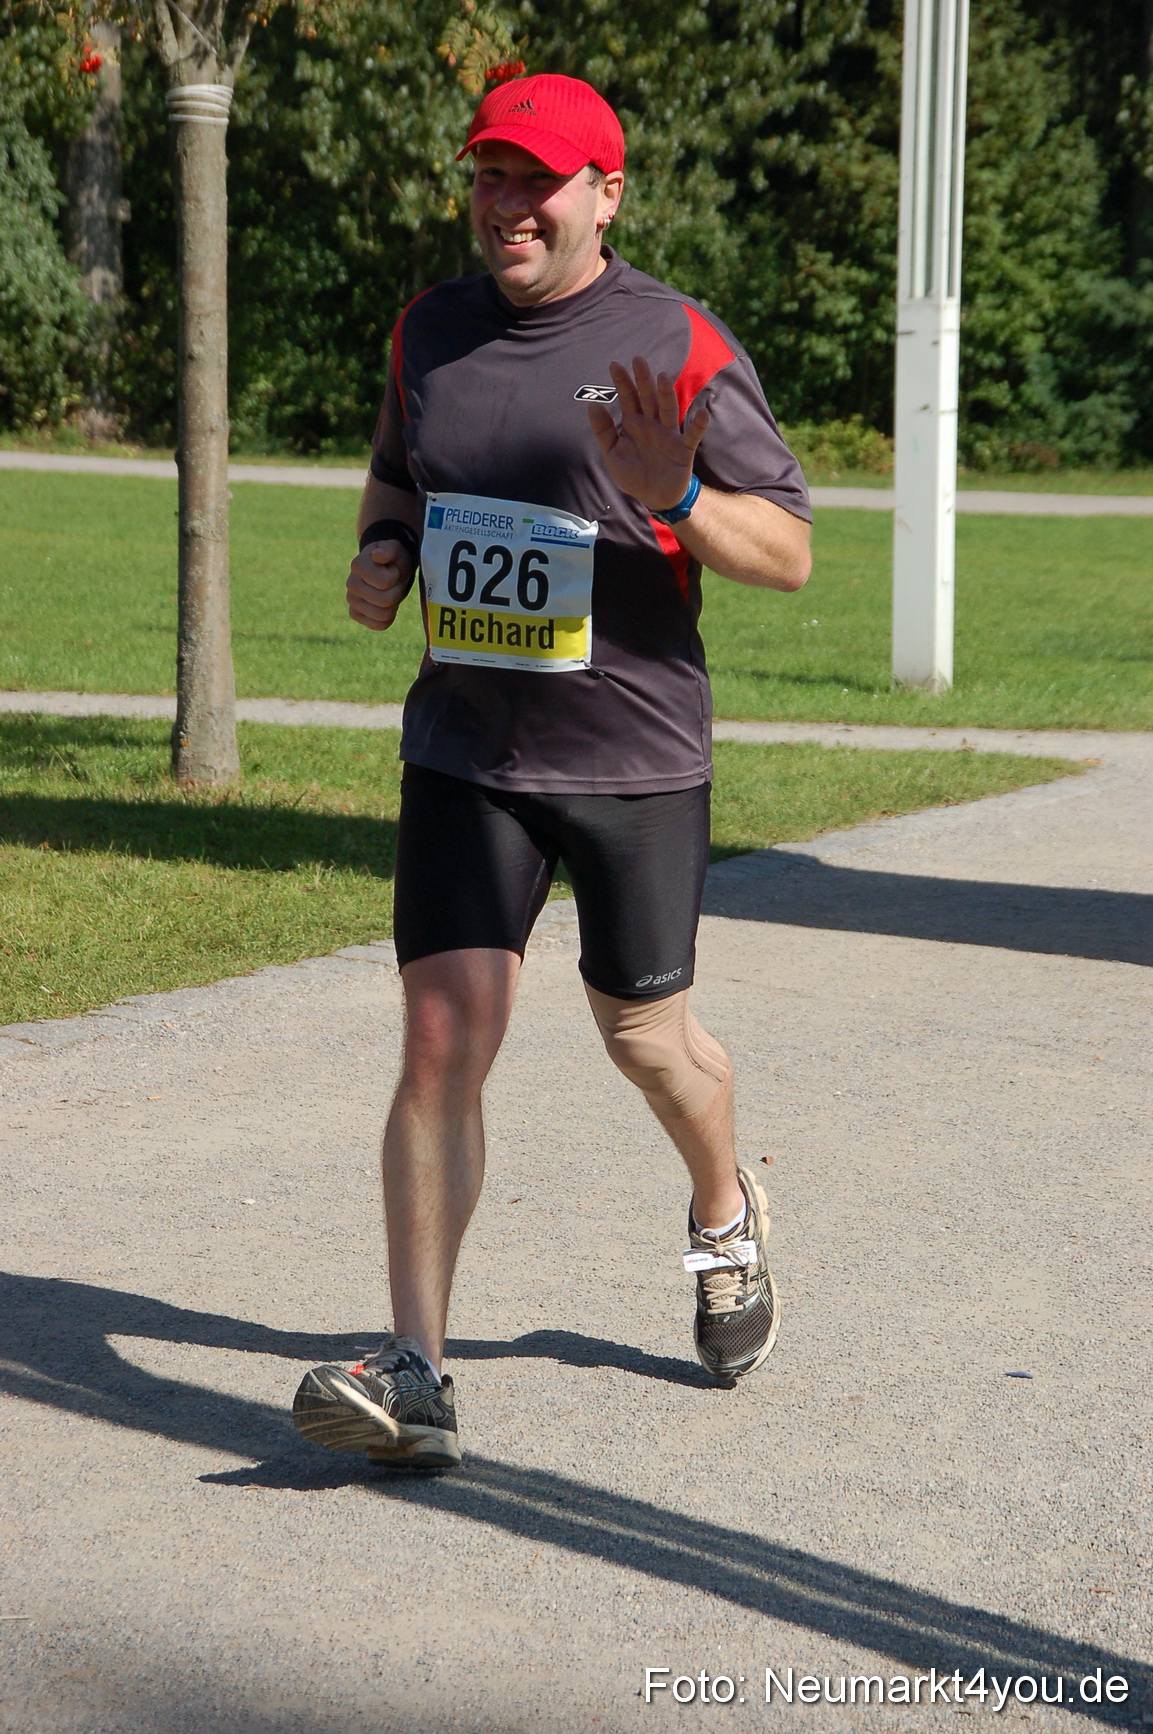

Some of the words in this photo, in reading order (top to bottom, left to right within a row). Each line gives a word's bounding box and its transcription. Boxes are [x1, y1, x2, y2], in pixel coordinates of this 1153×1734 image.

[445, 508, 514, 531] PFLEIDERER
[444, 524, 514, 540] AKTIENGESELLSCHAFT
[531, 523, 580, 540] BOCK
[447, 540, 549, 611] 626
[438, 606, 555, 650] Richard
[653, 967, 682, 985] asics
